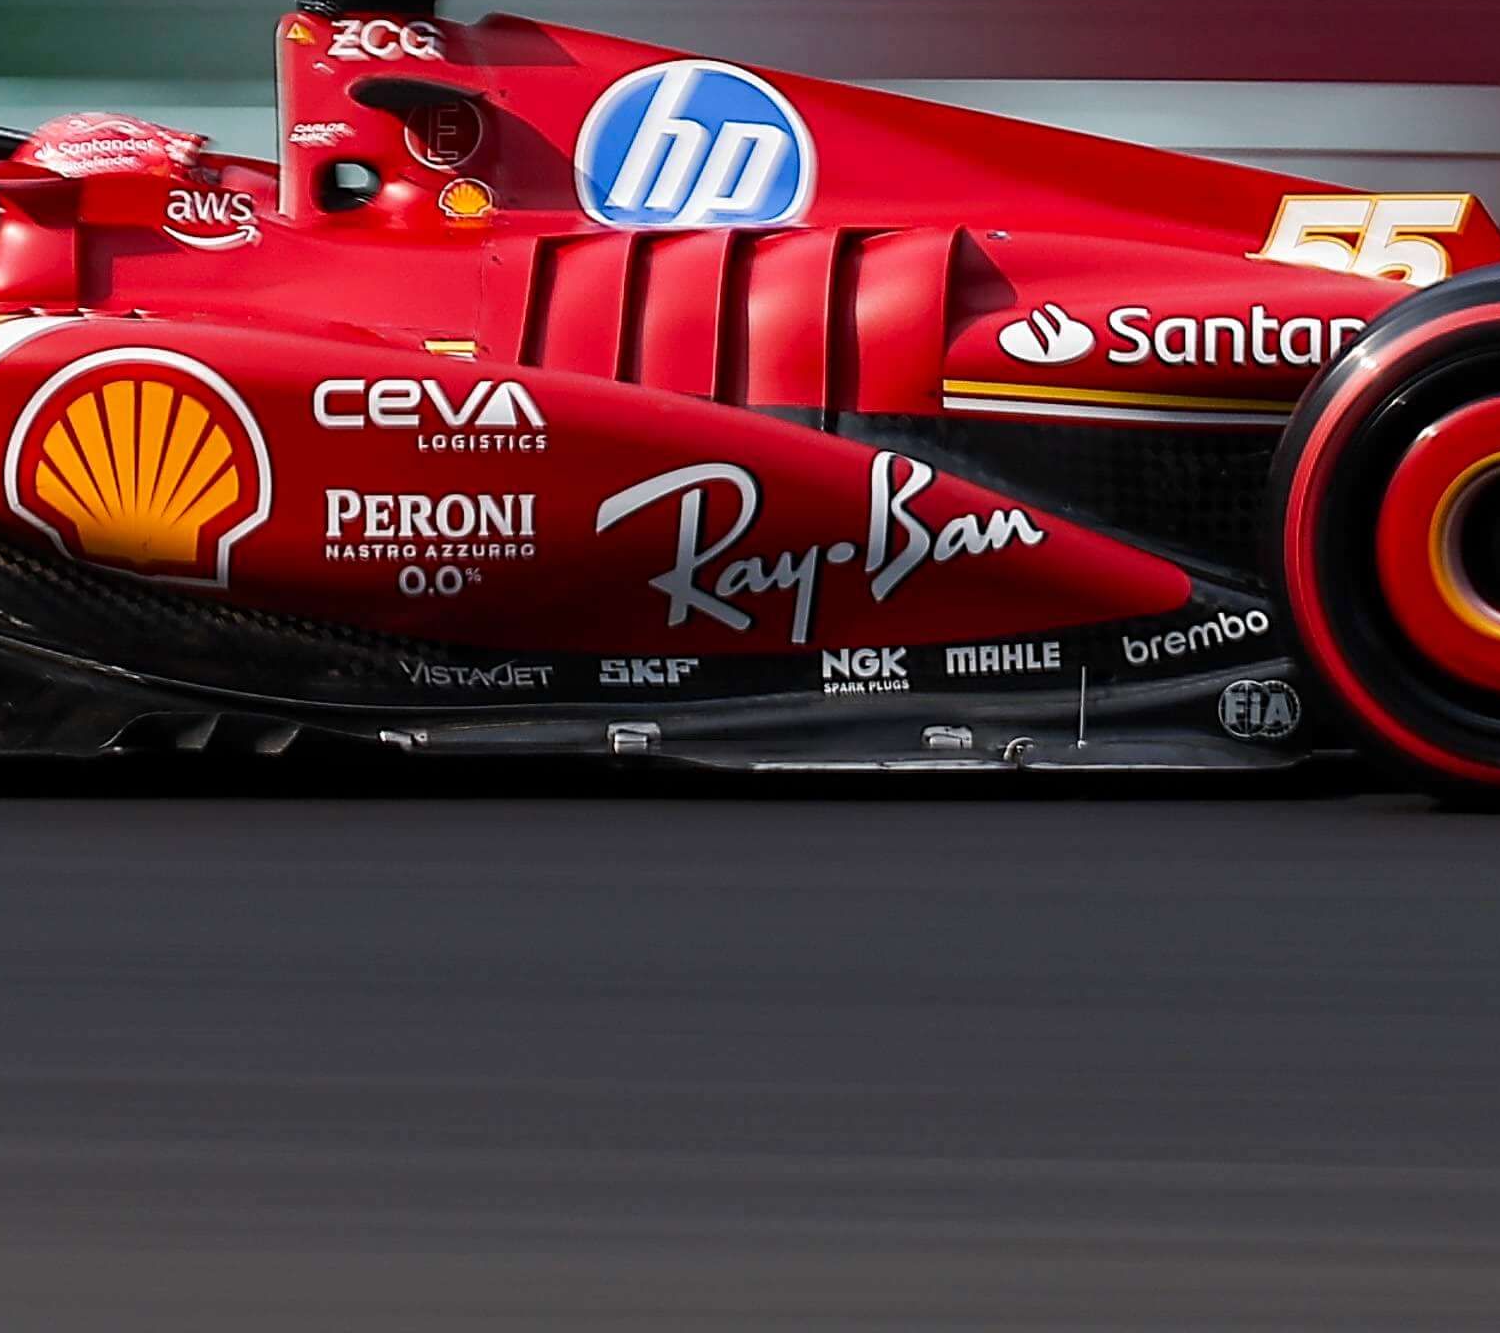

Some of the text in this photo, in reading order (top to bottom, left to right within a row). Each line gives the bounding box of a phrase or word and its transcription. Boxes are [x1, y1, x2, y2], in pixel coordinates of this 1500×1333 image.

[328, 19, 445, 61] ZCG
[58, 138, 154, 160] Santander
[604, 61, 791, 226] hp
[166, 189, 254, 222] aws
[1255, 192, 1475, 290] 55
[313, 378, 548, 430] CEVA
[417, 434, 548, 452] LOGISTICS
[324, 488, 537, 540] PERONI
[325, 543, 537, 561] NASTRO AZZURRO
[1121, 610, 1269, 664] brembo
[600, 658, 699, 685] SKF
[821, 646, 908, 679] NGK
[944, 641, 1062, 674] MAHLE
[823, 679, 911, 695] SPARK PLUGS
